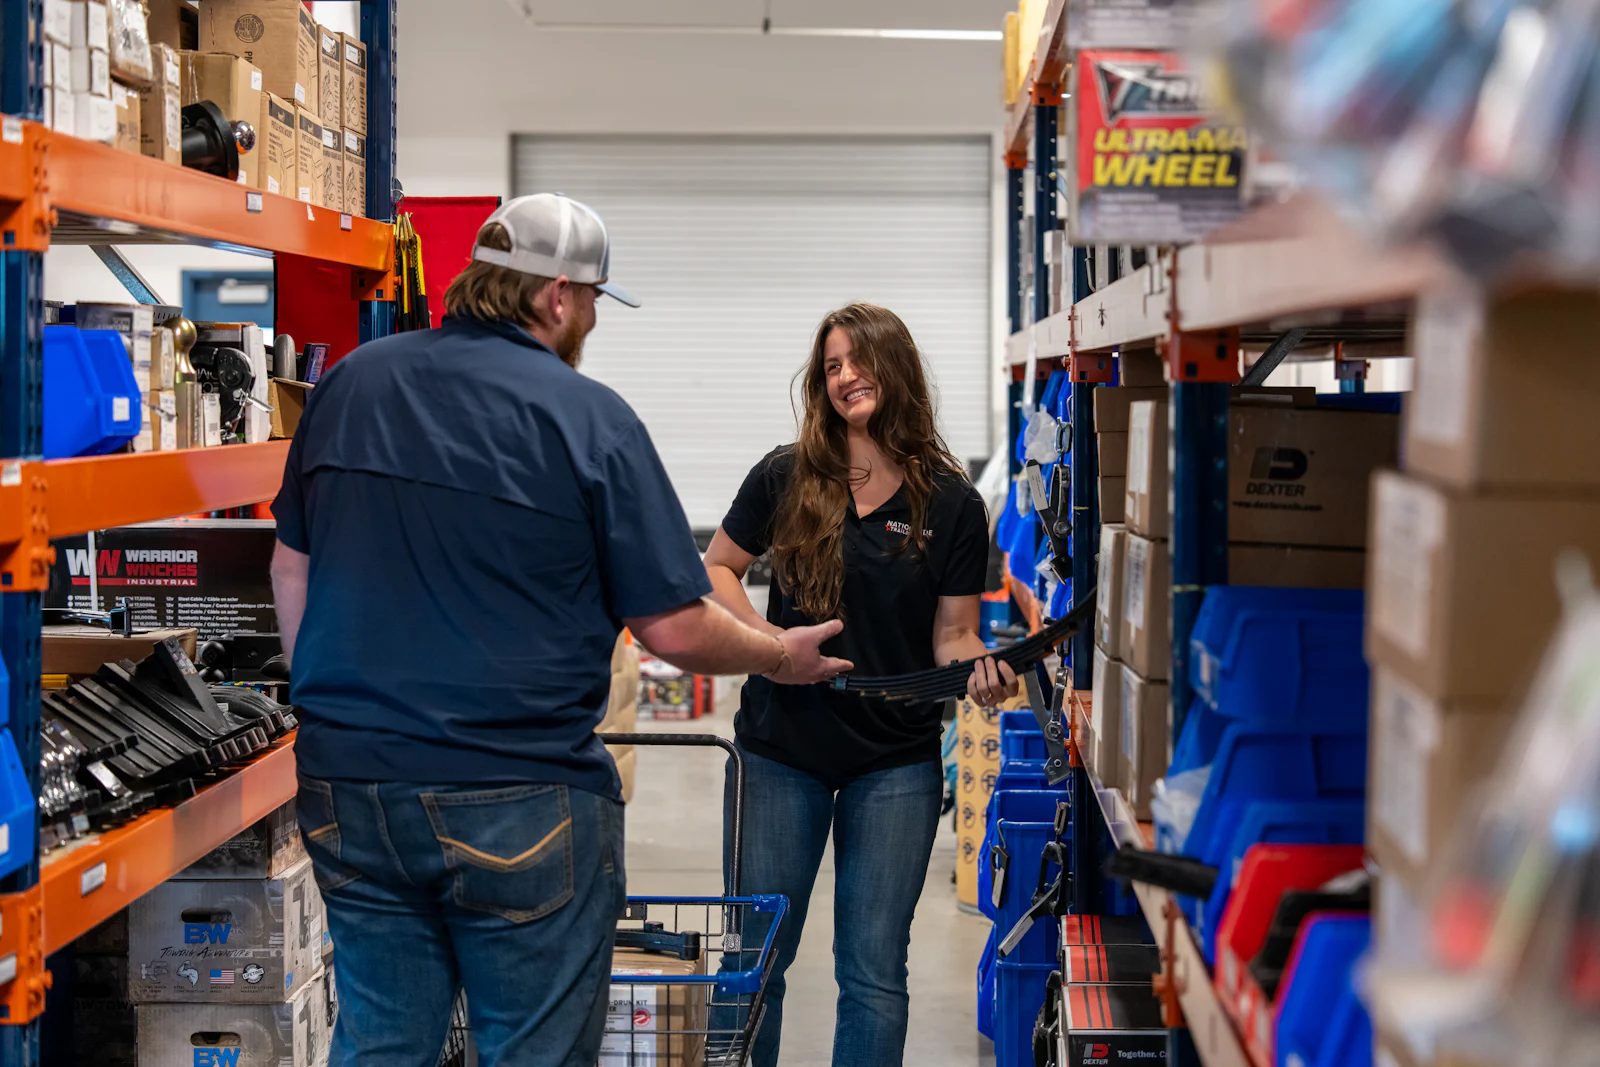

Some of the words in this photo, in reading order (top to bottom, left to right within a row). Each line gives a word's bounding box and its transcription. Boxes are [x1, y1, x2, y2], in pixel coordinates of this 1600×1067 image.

[1094, 127, 1248, 152] ULTRA-MA
[1093, 153, 1238, 187] WHEEL
[1246, 482, 1306, 497] DEXTER
[887, 519, 933, 536] NATIODE
[890, 526, 910, 536] TRAILE
[125, 549, 198, 562] WARRIOR
[125, 563, 198, 576] WINCHES
[126, 578, 196, 586] INDUSTRIAL
[1117, 1050, 1157, 1059] Together.
